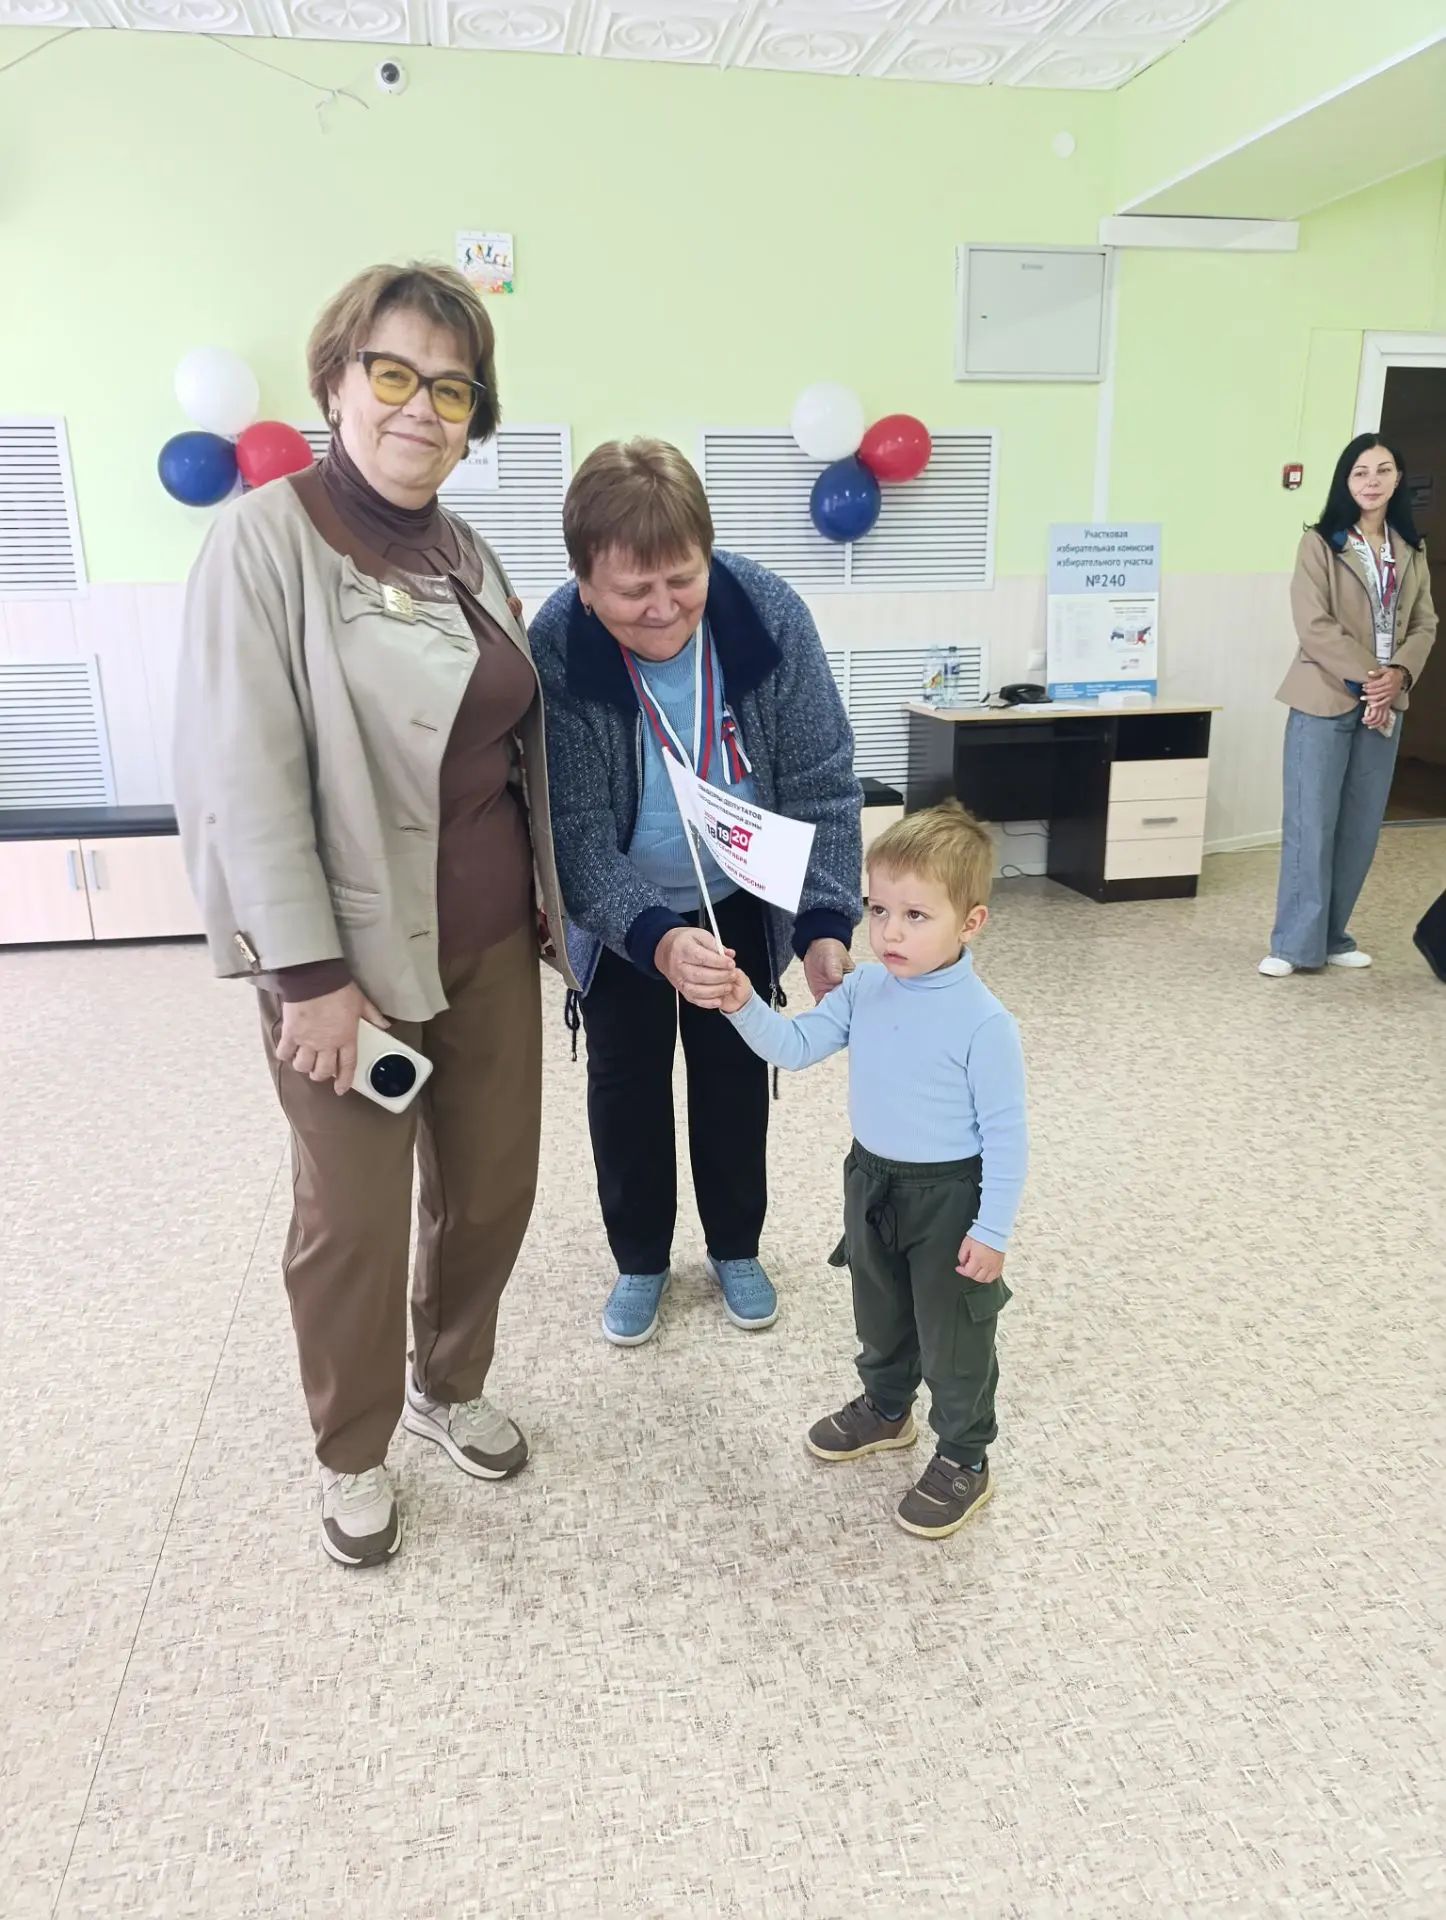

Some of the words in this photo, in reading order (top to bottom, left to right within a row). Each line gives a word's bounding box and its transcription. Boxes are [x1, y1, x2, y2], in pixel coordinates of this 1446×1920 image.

[1084, 529, 1129, 539] Участковая
[1056, 543, 1116, 554] избирательная
[1117, 544, 1155, 553] комиссия
[1056, 557, 1121, 568] избирательного
[1123, 558, 1154, 567] участка
[1085, 573, 1126, 588] №240
[723, 798, 762, 821] ДЕПУТАТОВ
[717, 826, 730, 842] 19
[731, 829, 748, 846] 20
